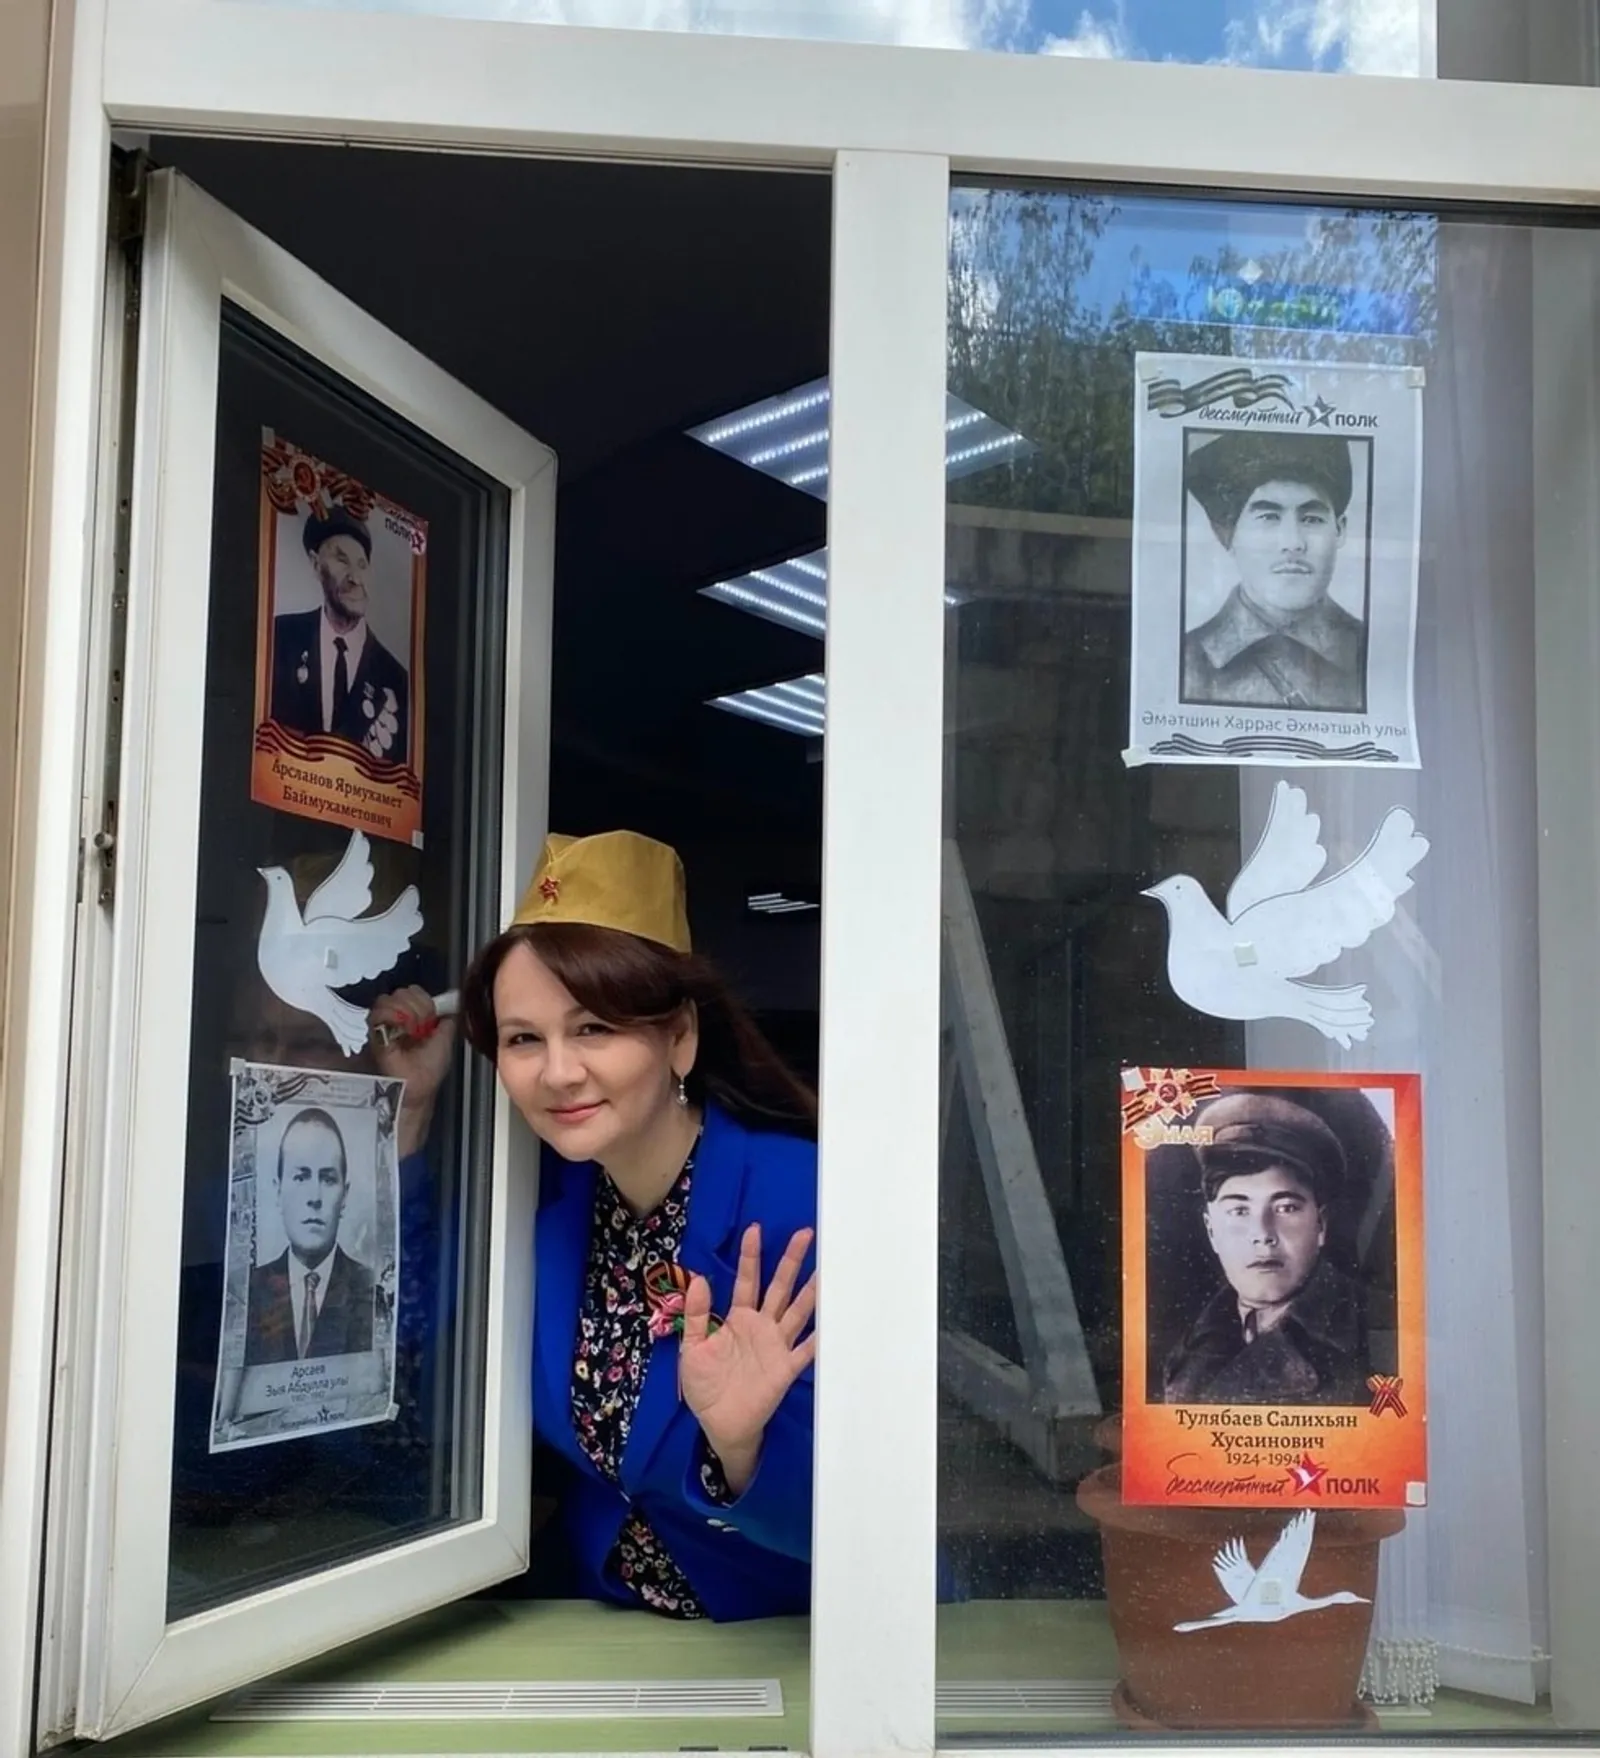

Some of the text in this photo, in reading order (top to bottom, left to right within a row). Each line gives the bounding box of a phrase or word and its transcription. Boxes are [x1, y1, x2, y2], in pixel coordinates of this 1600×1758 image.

[1335, 413, 1378, 428] ПОЛК
[1224, 714, 1283, 734] Харрас
[1375, 724, 1408, 738] улы
[272, 758, 403, 808] Арсланов Ярмухамет
[283, 785, 392, 828] Баймухаметович
[1175, 1409, 1358, 1430] Тулябаев Салихьян
[1211, 1432, 1324, 1452] Хусаинович
[1226, 1452, 1301, 1467] 1924-1994
[1326, 1478, 1380, 1495] ПОЛК
